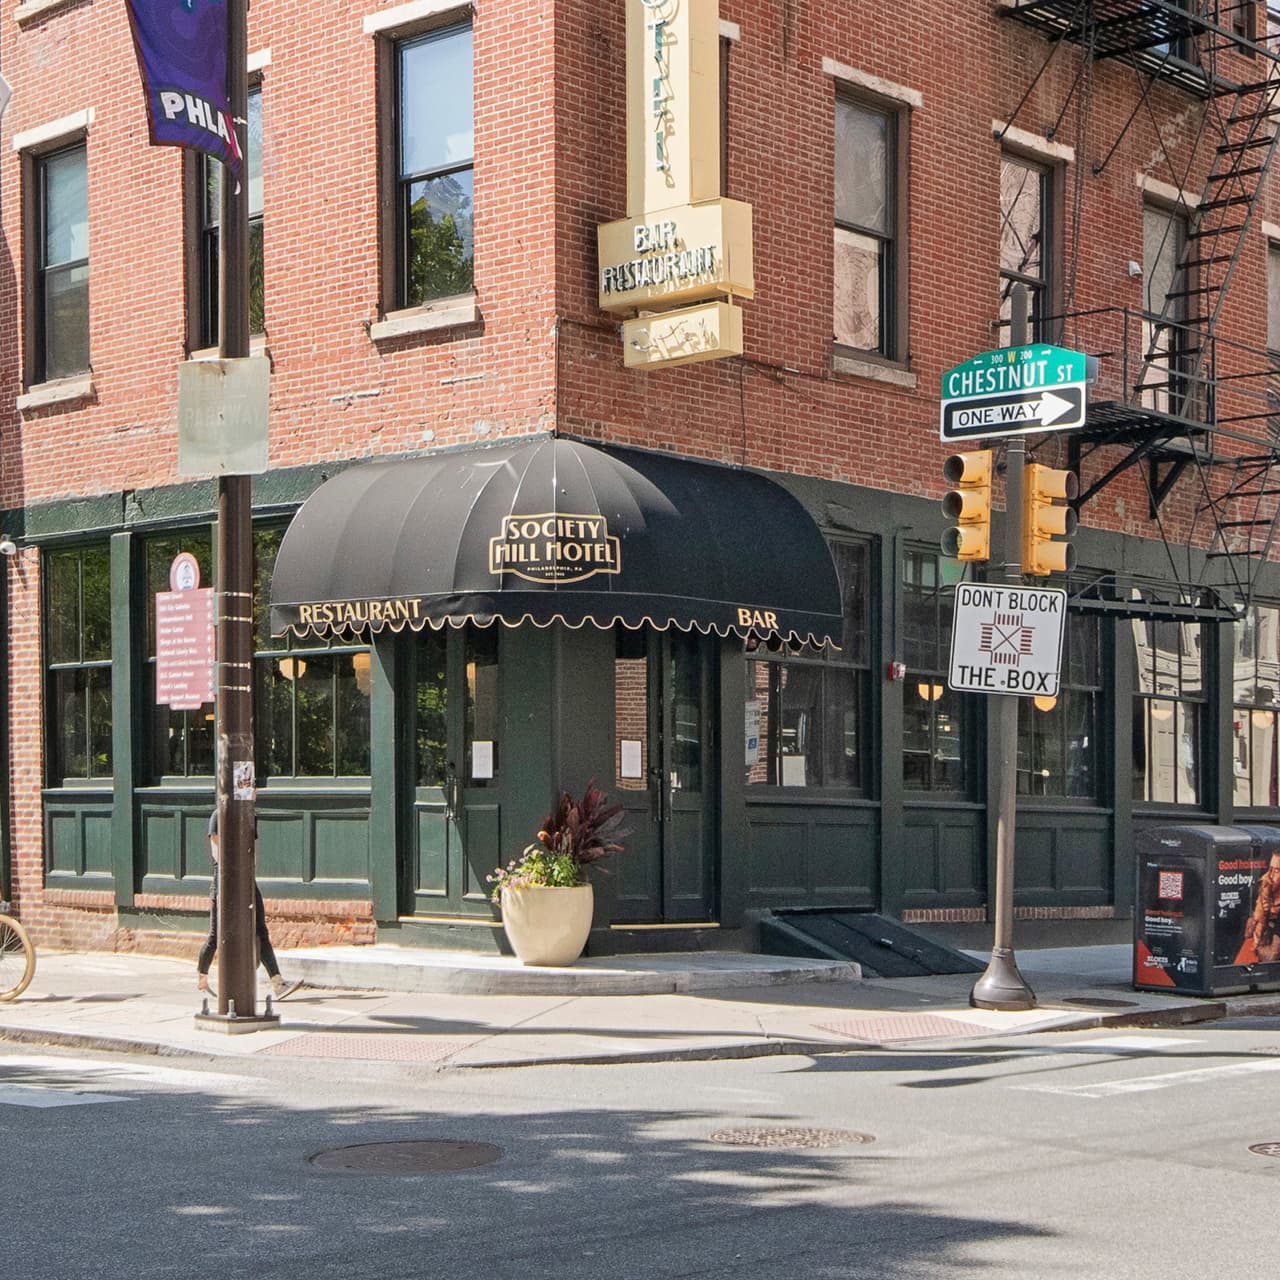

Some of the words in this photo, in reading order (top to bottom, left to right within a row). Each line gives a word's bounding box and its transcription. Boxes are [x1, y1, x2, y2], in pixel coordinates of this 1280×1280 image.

[634, 220, 677, 252] BAR
[601, 244, 716, 296] RESTAURANT
[991, 354, 1003, 365] 300
[1007, 351, 1016, 363] W
[949, 360, 1048, 397] CHESTNUT
[1057, 364, 1073, 382] ST
[959, 408, 994, 426] ONE
[1000, 403, 1040, 421] WAY
[508, 519, 600, 539] SOCIETY
[495, 543, 540, 564] HILL
[546, 541, 615, 563] HOTEL
[300, 599, 422, 623] RESTAURANT
[1008, 592, 1058, 613] BLOCK
[738, 608, 779, 630] BAR
[958, 665, 996, 687] THE
[1006, 668, 1050, 693] BOX
[1218, 860, 1239, 870] Good
[1218, 875, 1238, 885] Good
[1239, 874, 1255, 887] boy.
